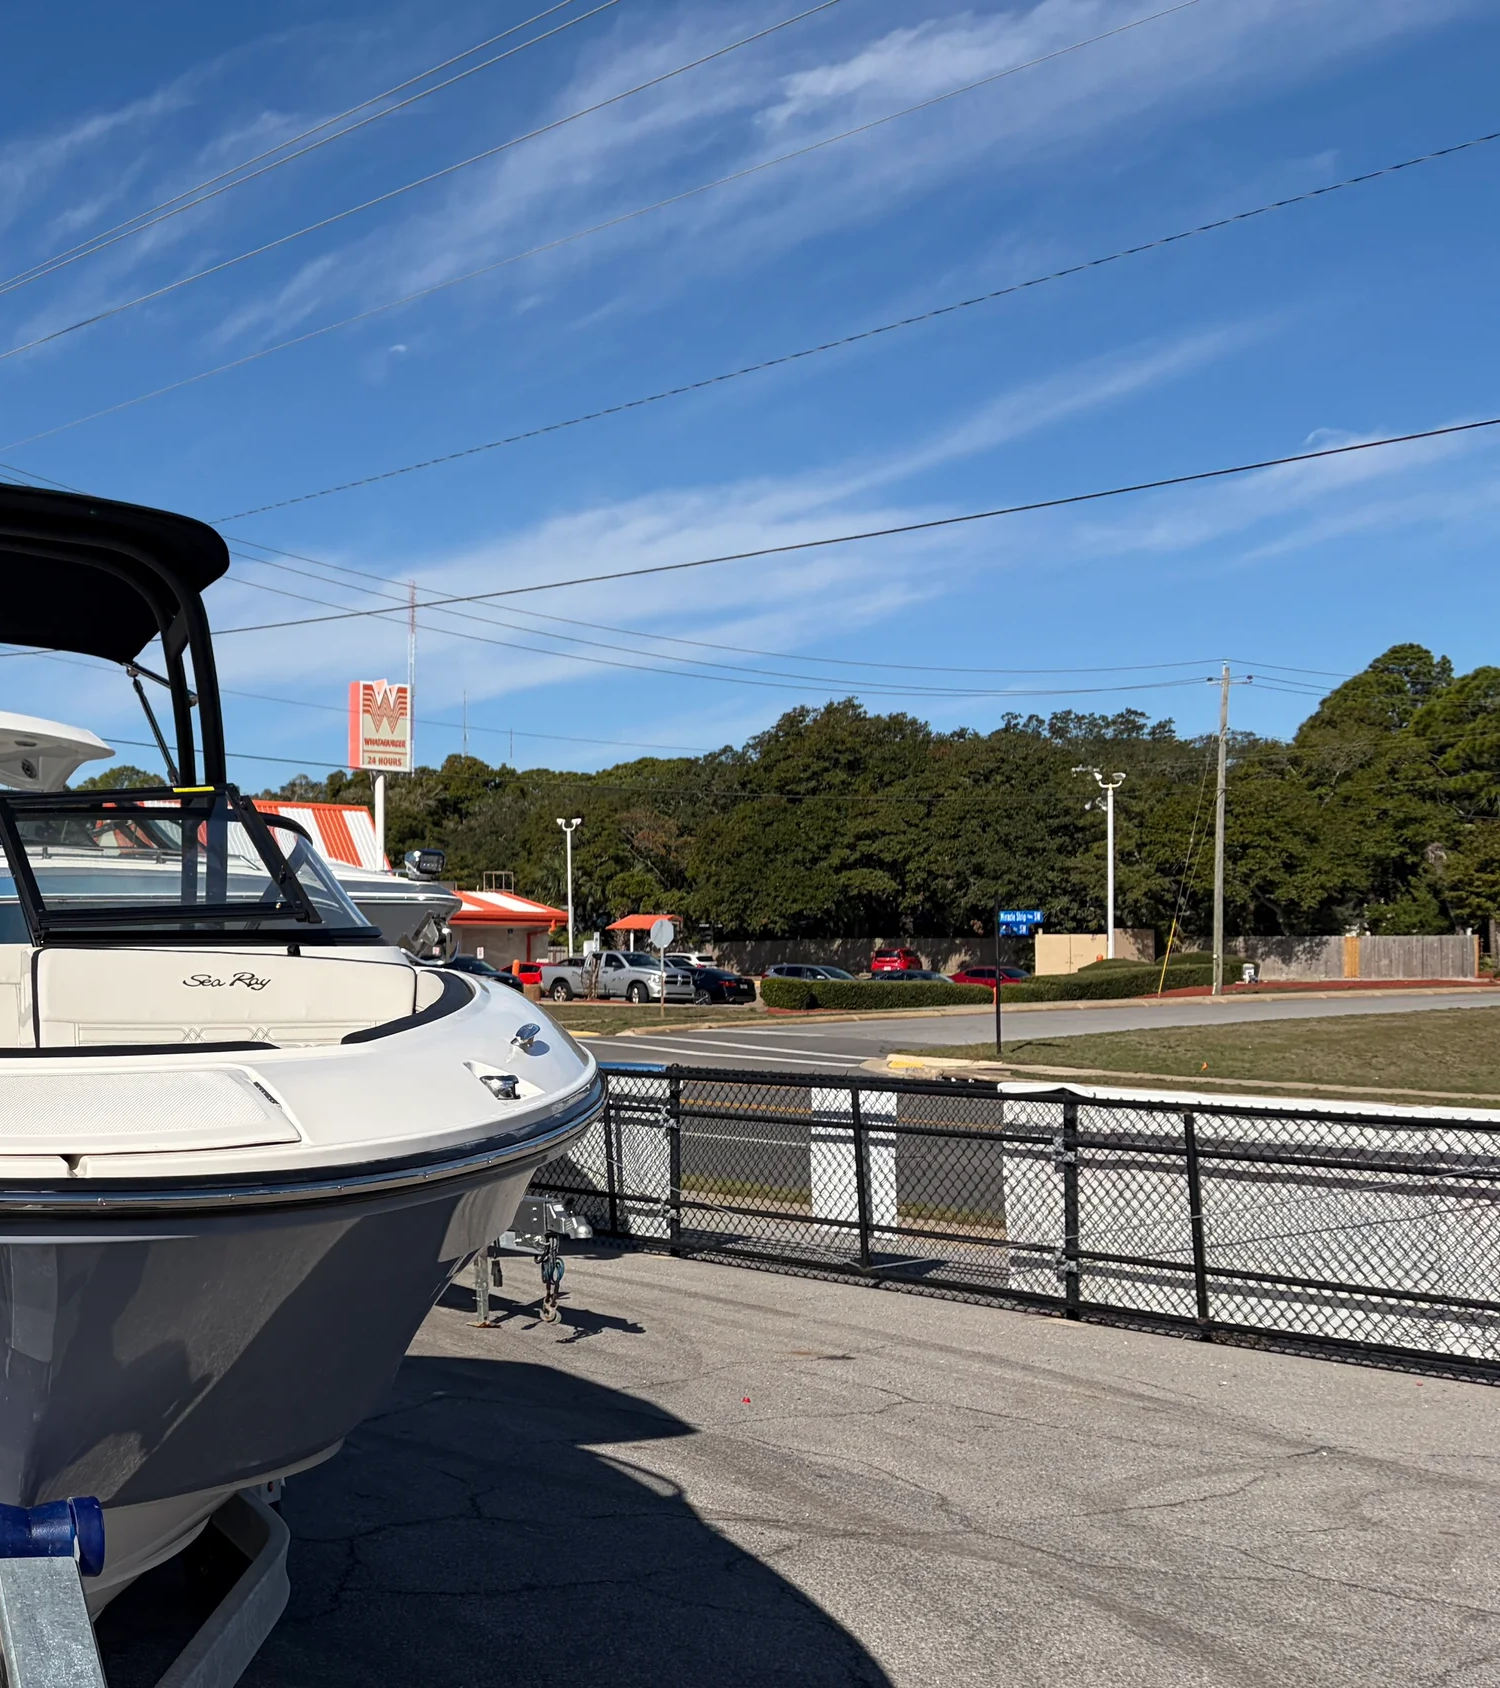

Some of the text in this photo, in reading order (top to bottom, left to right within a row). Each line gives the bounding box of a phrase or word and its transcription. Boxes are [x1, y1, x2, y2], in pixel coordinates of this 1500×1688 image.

[364, 738, 406, 748] WHATABURGER
[367, 756, 402, 766] 24 HOURS
[182, 972, 271, 991] Sea Ray
